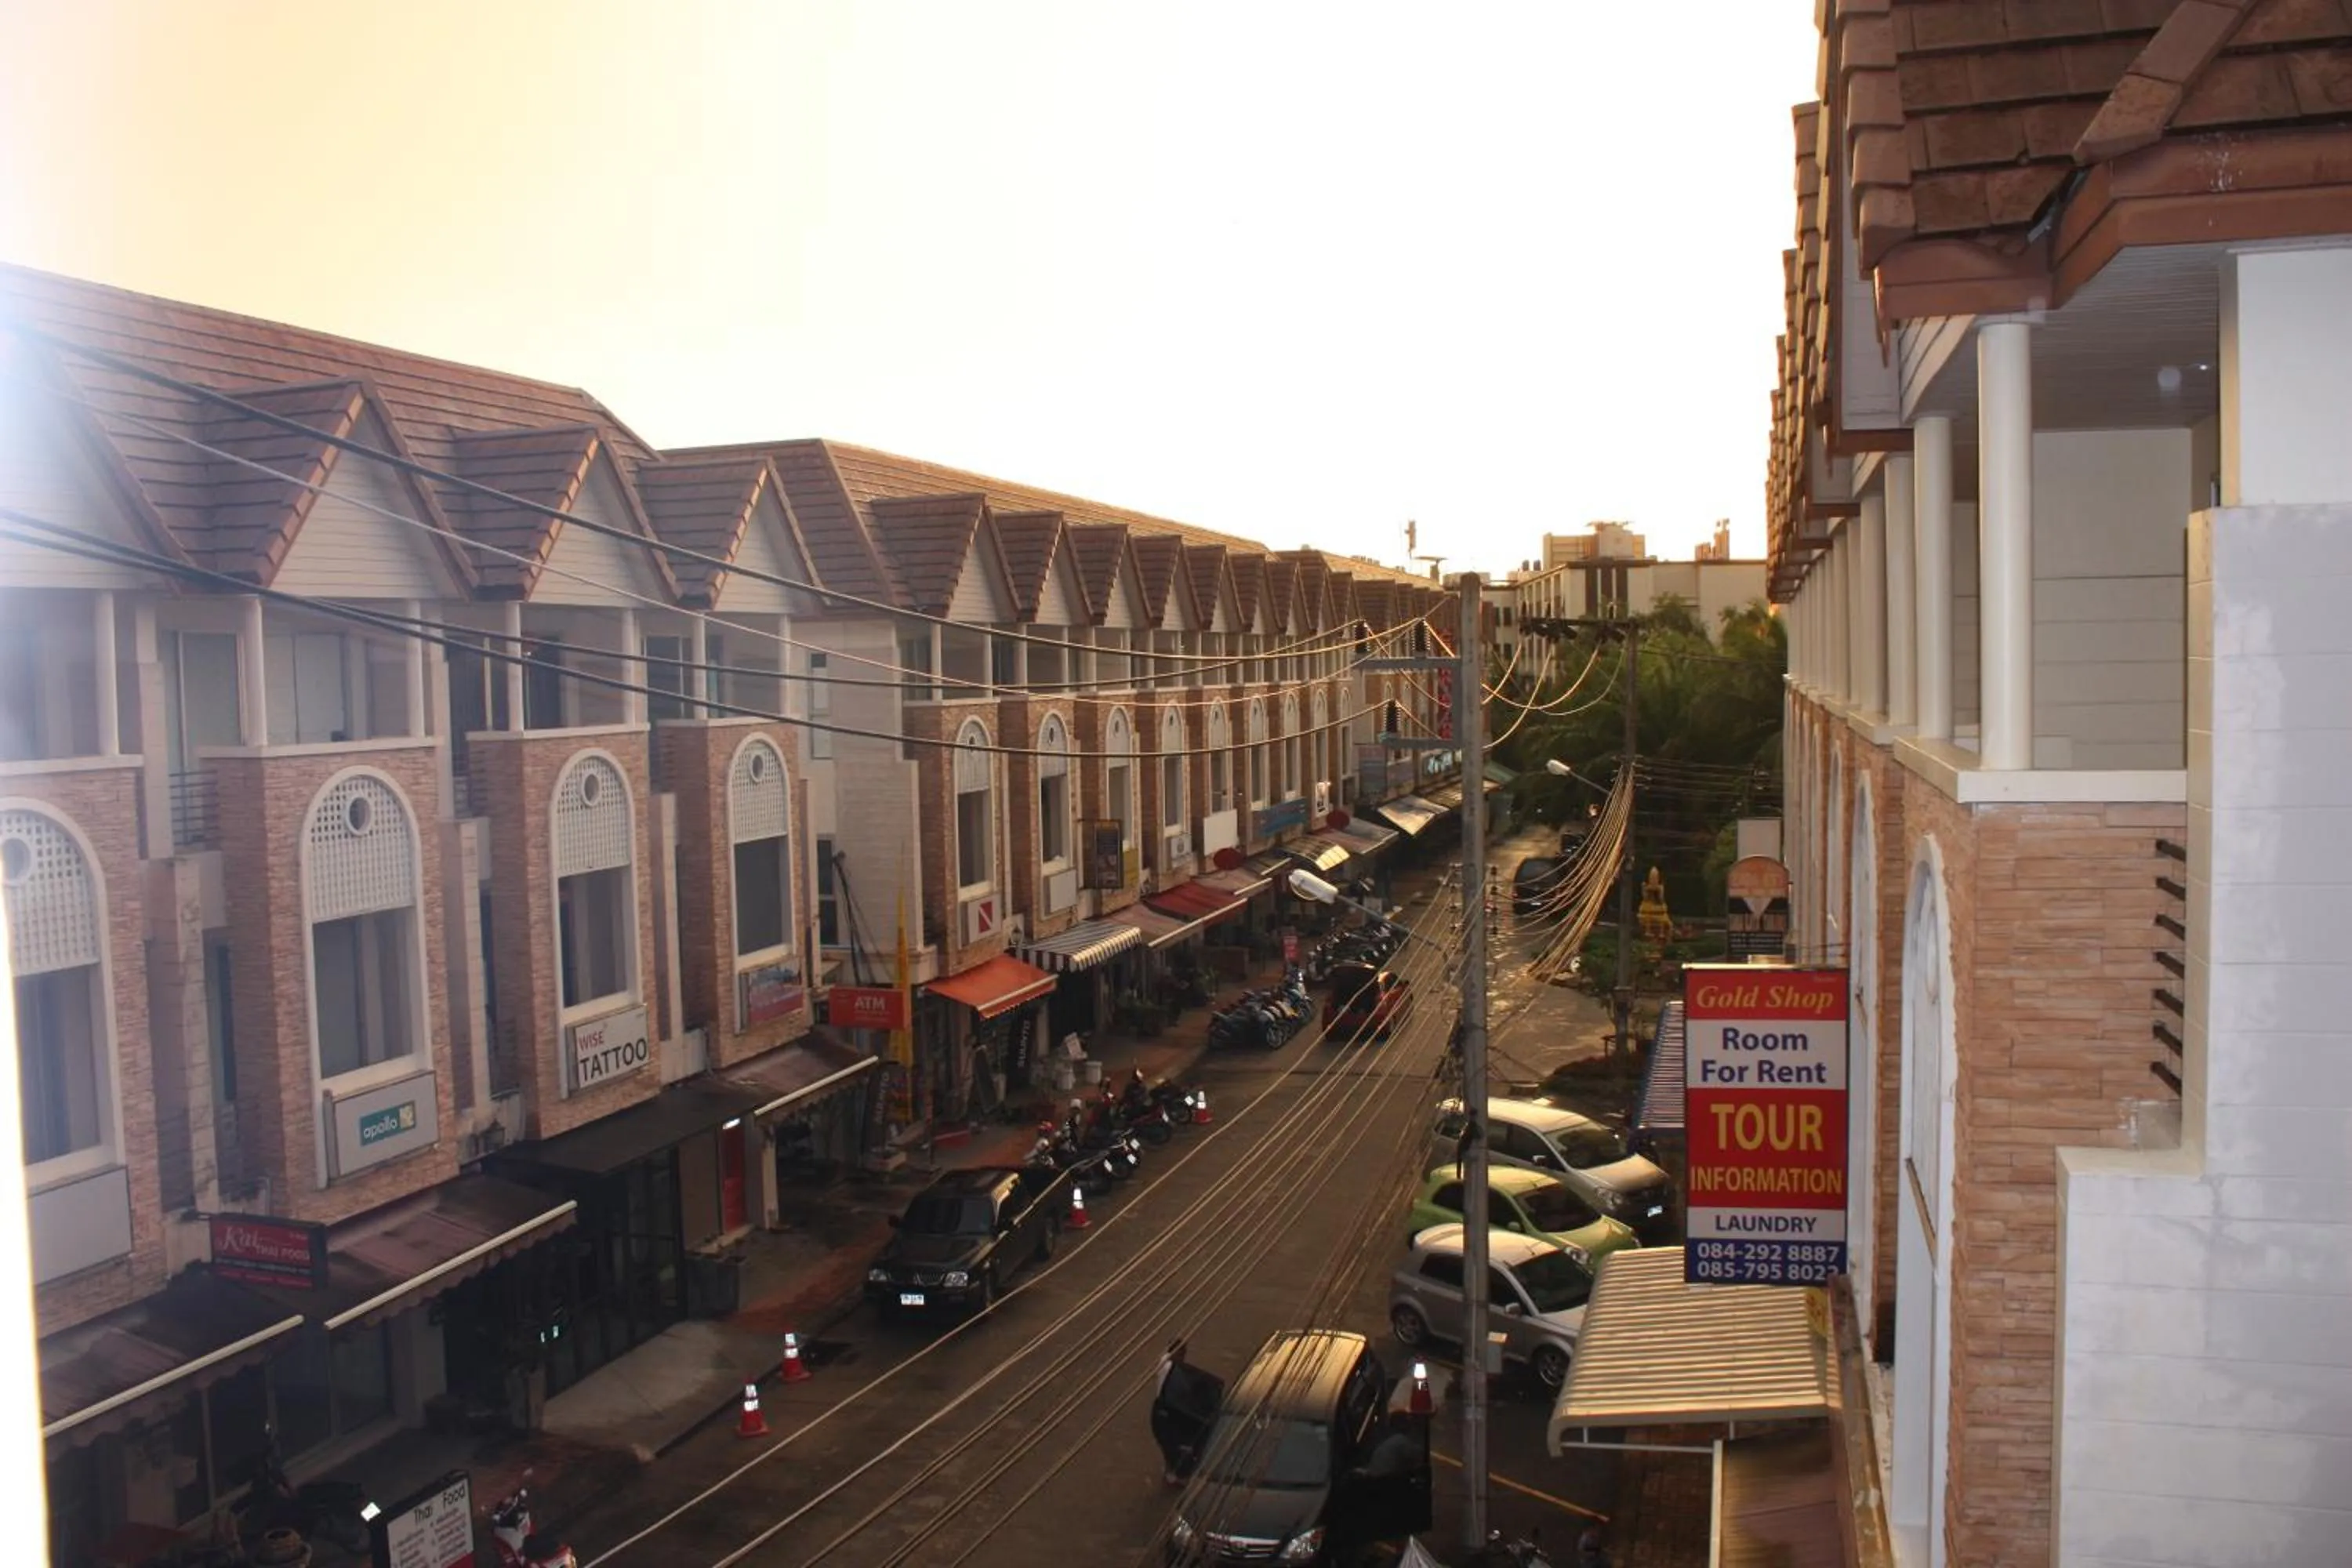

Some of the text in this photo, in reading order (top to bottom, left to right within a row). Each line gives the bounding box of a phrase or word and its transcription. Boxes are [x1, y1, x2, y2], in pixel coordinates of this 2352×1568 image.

[854, 996, 886, 1011] ATM
[1696, 985, 1834, 1014] Gold Shop
[579, 1030, 604, 1051] WISE
[1722, 1026, 1809, 1051] Room
[579, 1037, 647, 1082] TATTOO
[1700, 1059, 1827, 1083] For Rent
[1710, 1103, 1824, 1152] TOUR
[1690, 1166, 1842, 1195] INFORMATION
[1715, 1214, 1817, 1233] LAUNDRY
[1697, 1242, 1839, 1263] 084-292 8887
[1697, 1261, 1782, 1279] 085-795
